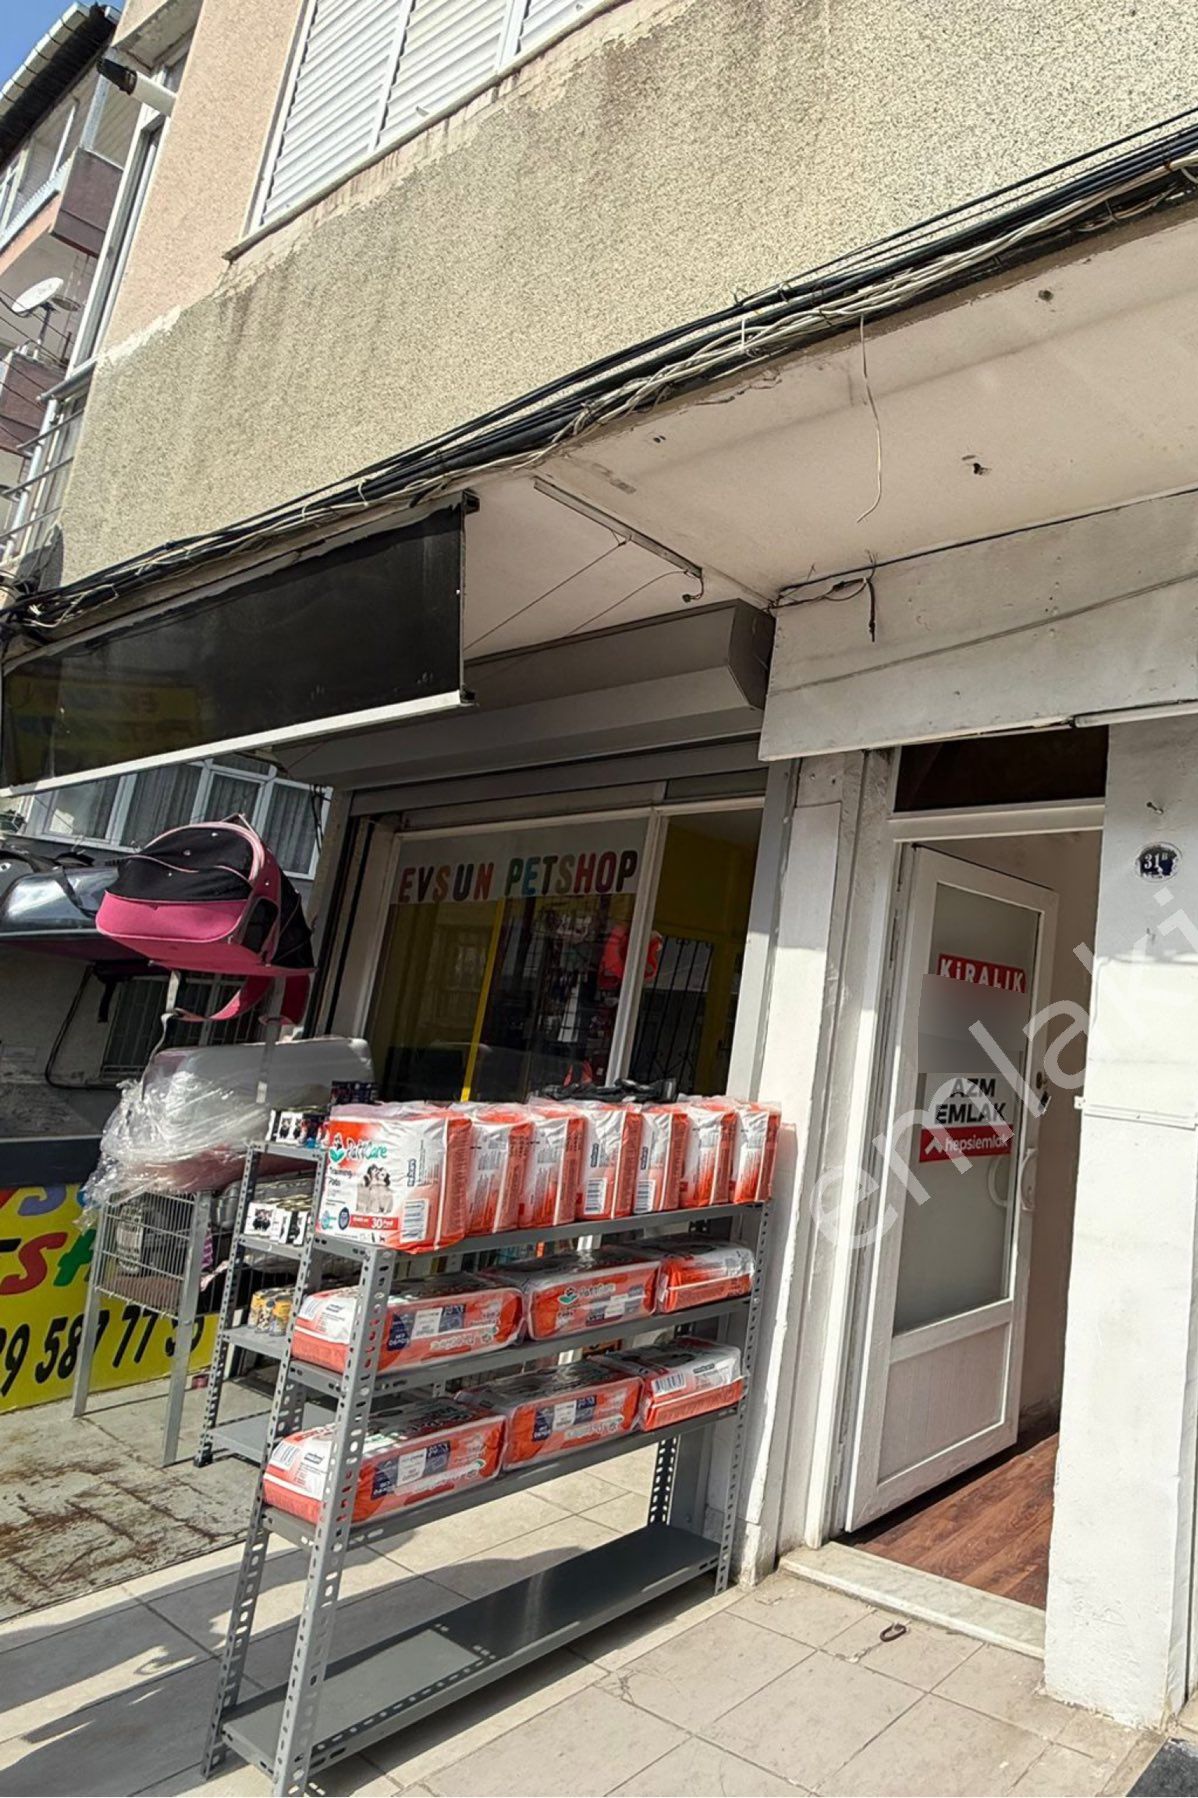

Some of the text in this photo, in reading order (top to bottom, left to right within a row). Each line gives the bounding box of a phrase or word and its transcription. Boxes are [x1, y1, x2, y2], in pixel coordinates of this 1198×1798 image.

[400, 851, 638, 901] EVSUN PETSHOP
[950, 1078, 996, 1098] AZM
[934, 1103, 1006, 1124] EMLAK
